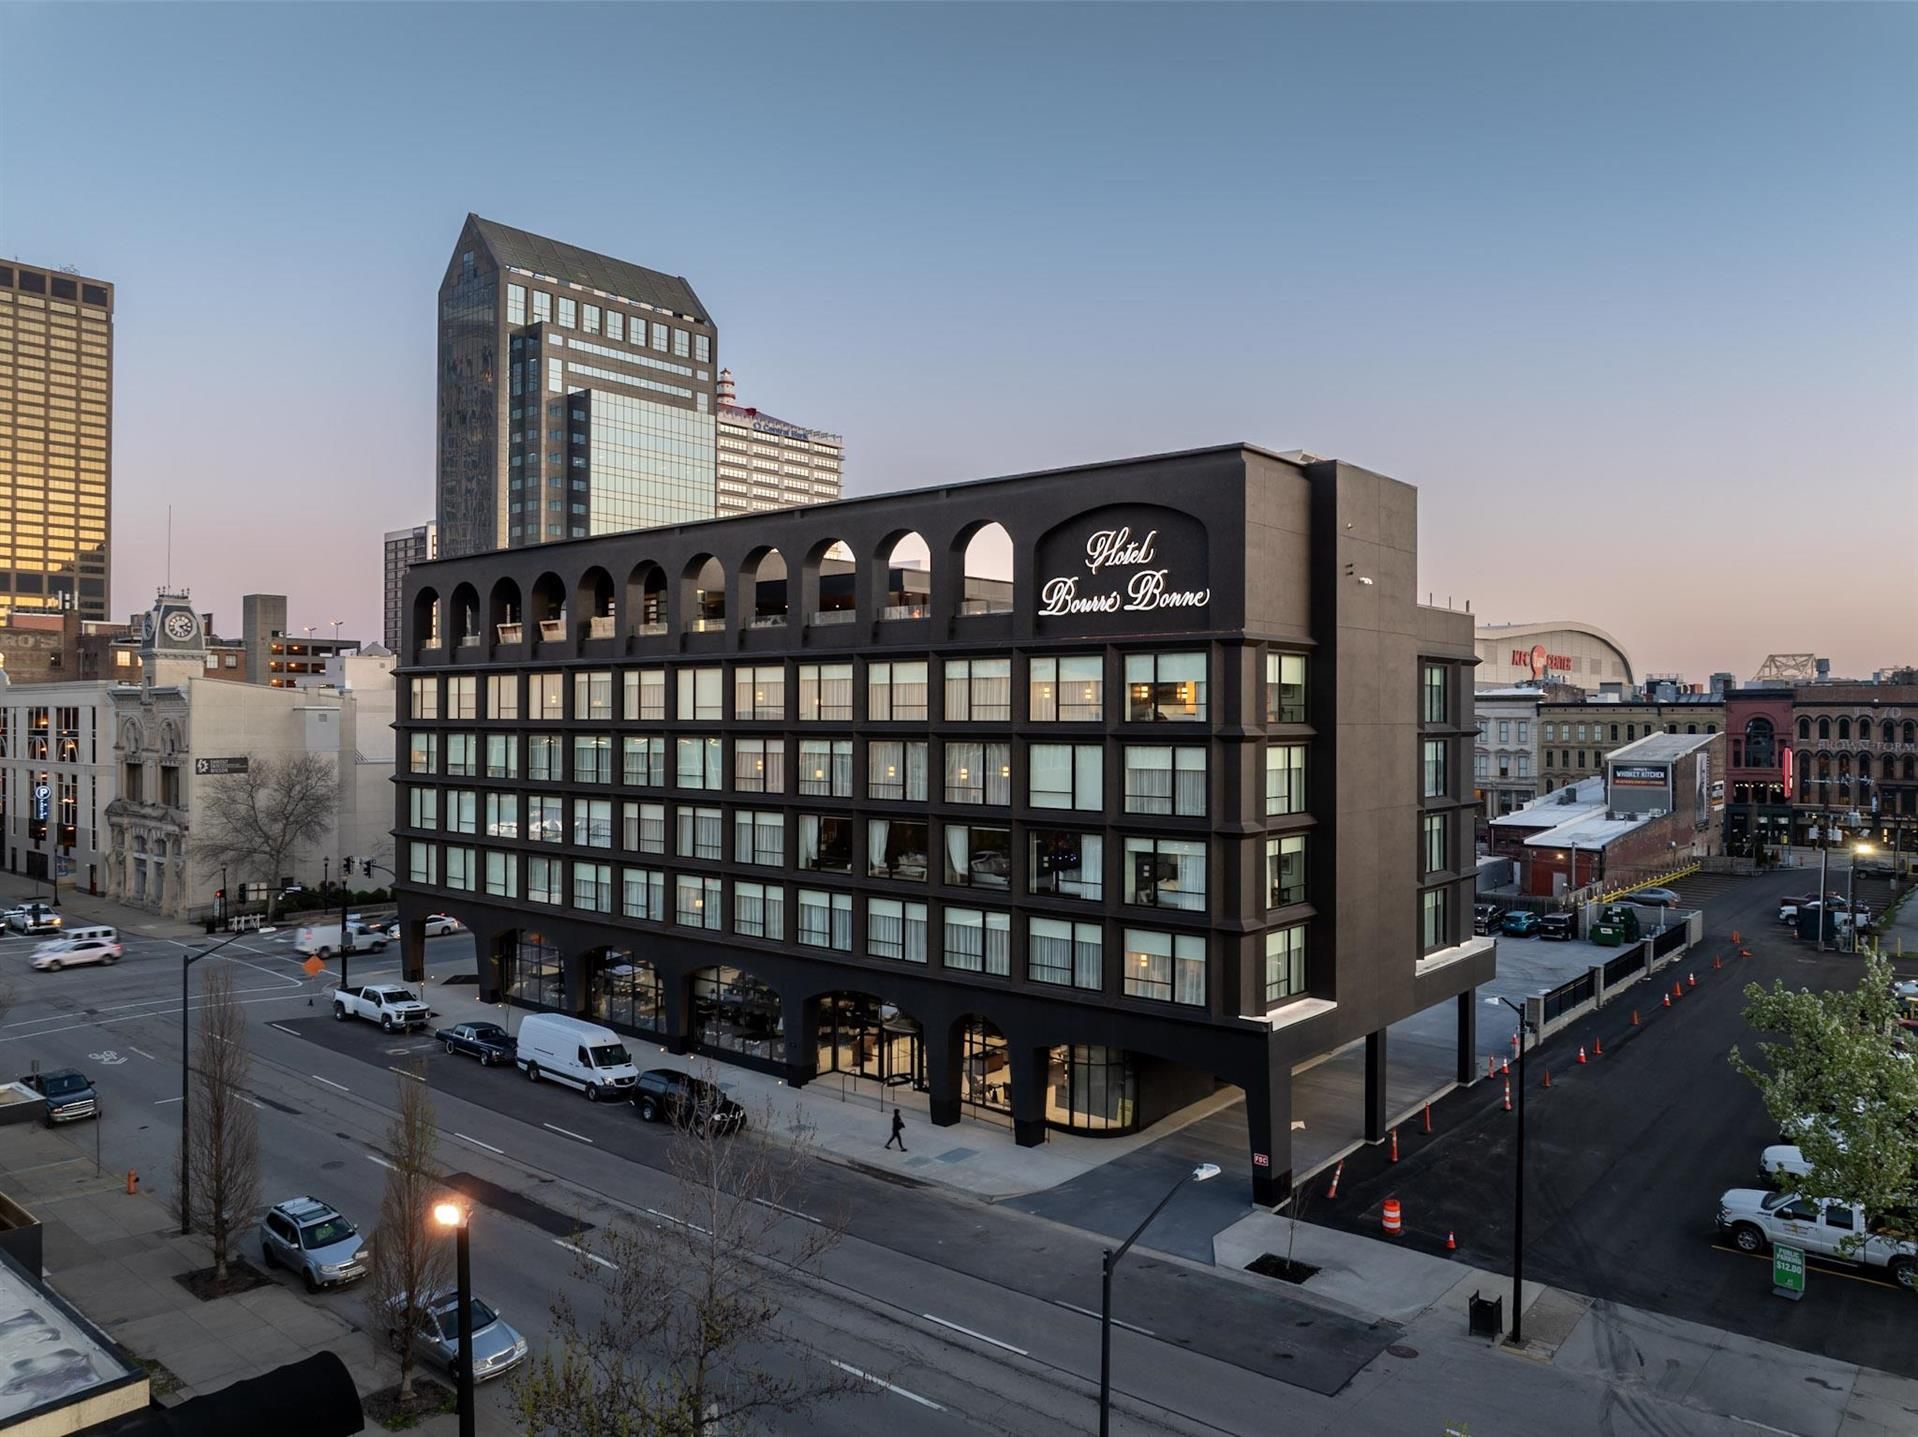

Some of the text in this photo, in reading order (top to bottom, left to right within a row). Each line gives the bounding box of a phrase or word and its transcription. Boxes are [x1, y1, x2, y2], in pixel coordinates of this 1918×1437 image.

[1085, 526, 1157, 575] Hotel
[1038, 569, 1210, 616] Bourré Bonne
[1511, 649, 1530, 667] KFC
[1546, 654, 1572, 671] CENTER
[1776, 1253, 1802, 1265] PARKING
[1778, 1247, 1800, 1259] PUBLIC
[1776, 1260, 1802, 1274] $12.00
